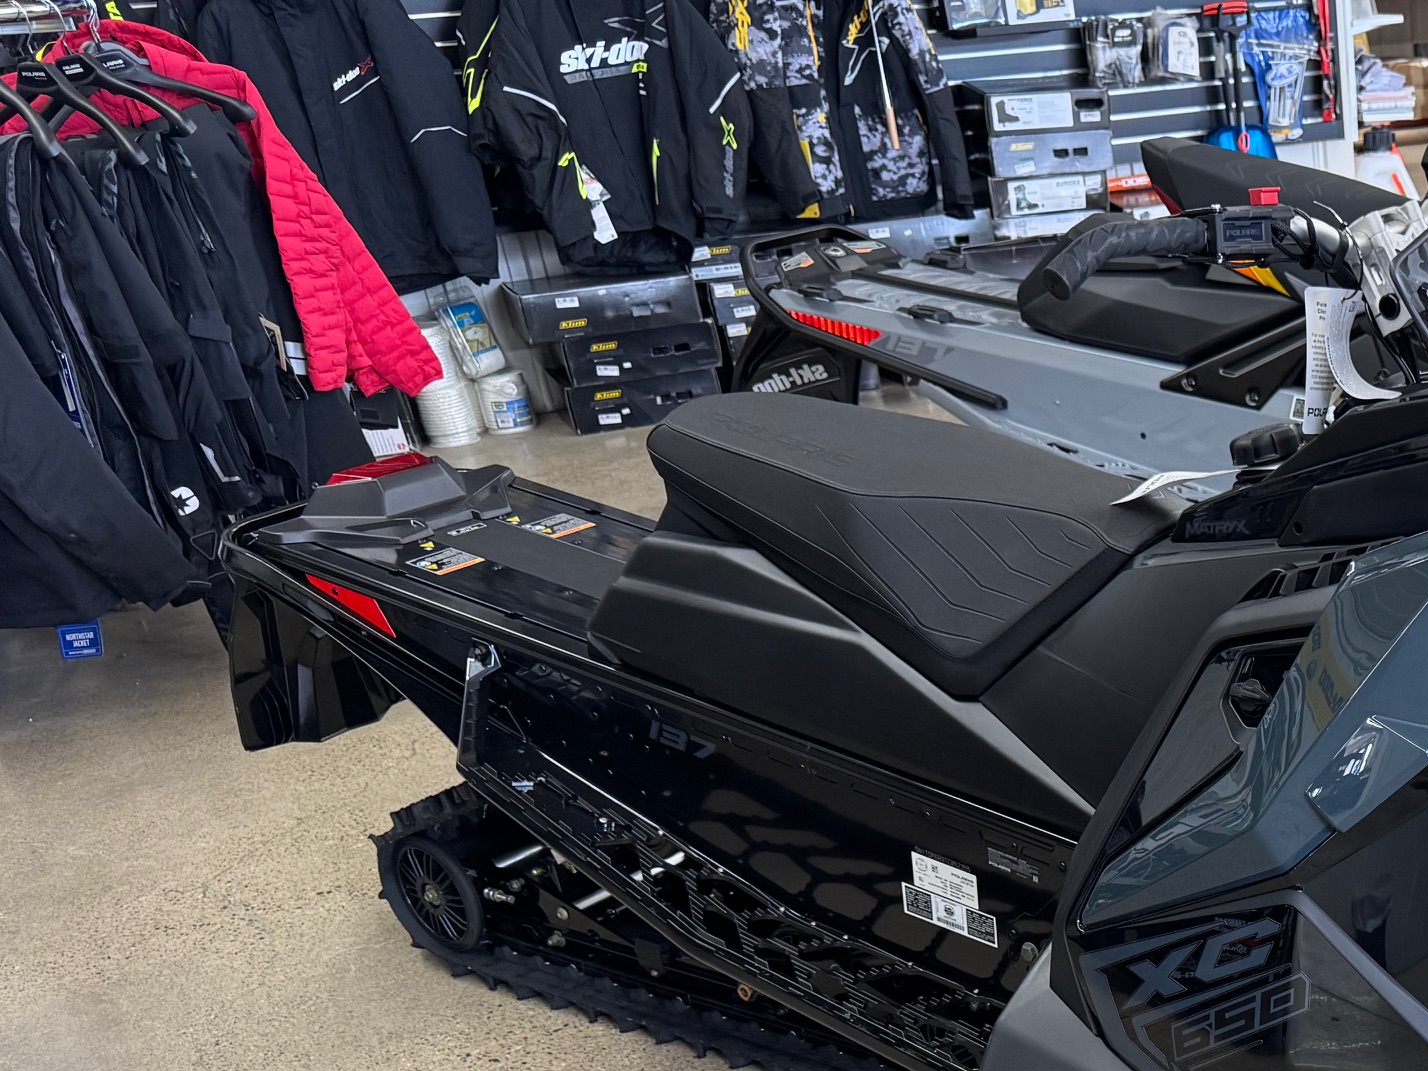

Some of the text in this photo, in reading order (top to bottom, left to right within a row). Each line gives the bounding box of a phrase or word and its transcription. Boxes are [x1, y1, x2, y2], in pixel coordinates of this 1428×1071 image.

[560, 37, 649, 74] ski-doo
[1226, 228, 1262, 238] POLARIS
[1184, 520, 1250, 539] MATRYX
[649, 720, 717, 759] 137
[1122, 917, 1283, 1011] XC
[1171, 971, 1312, 1061] 650
